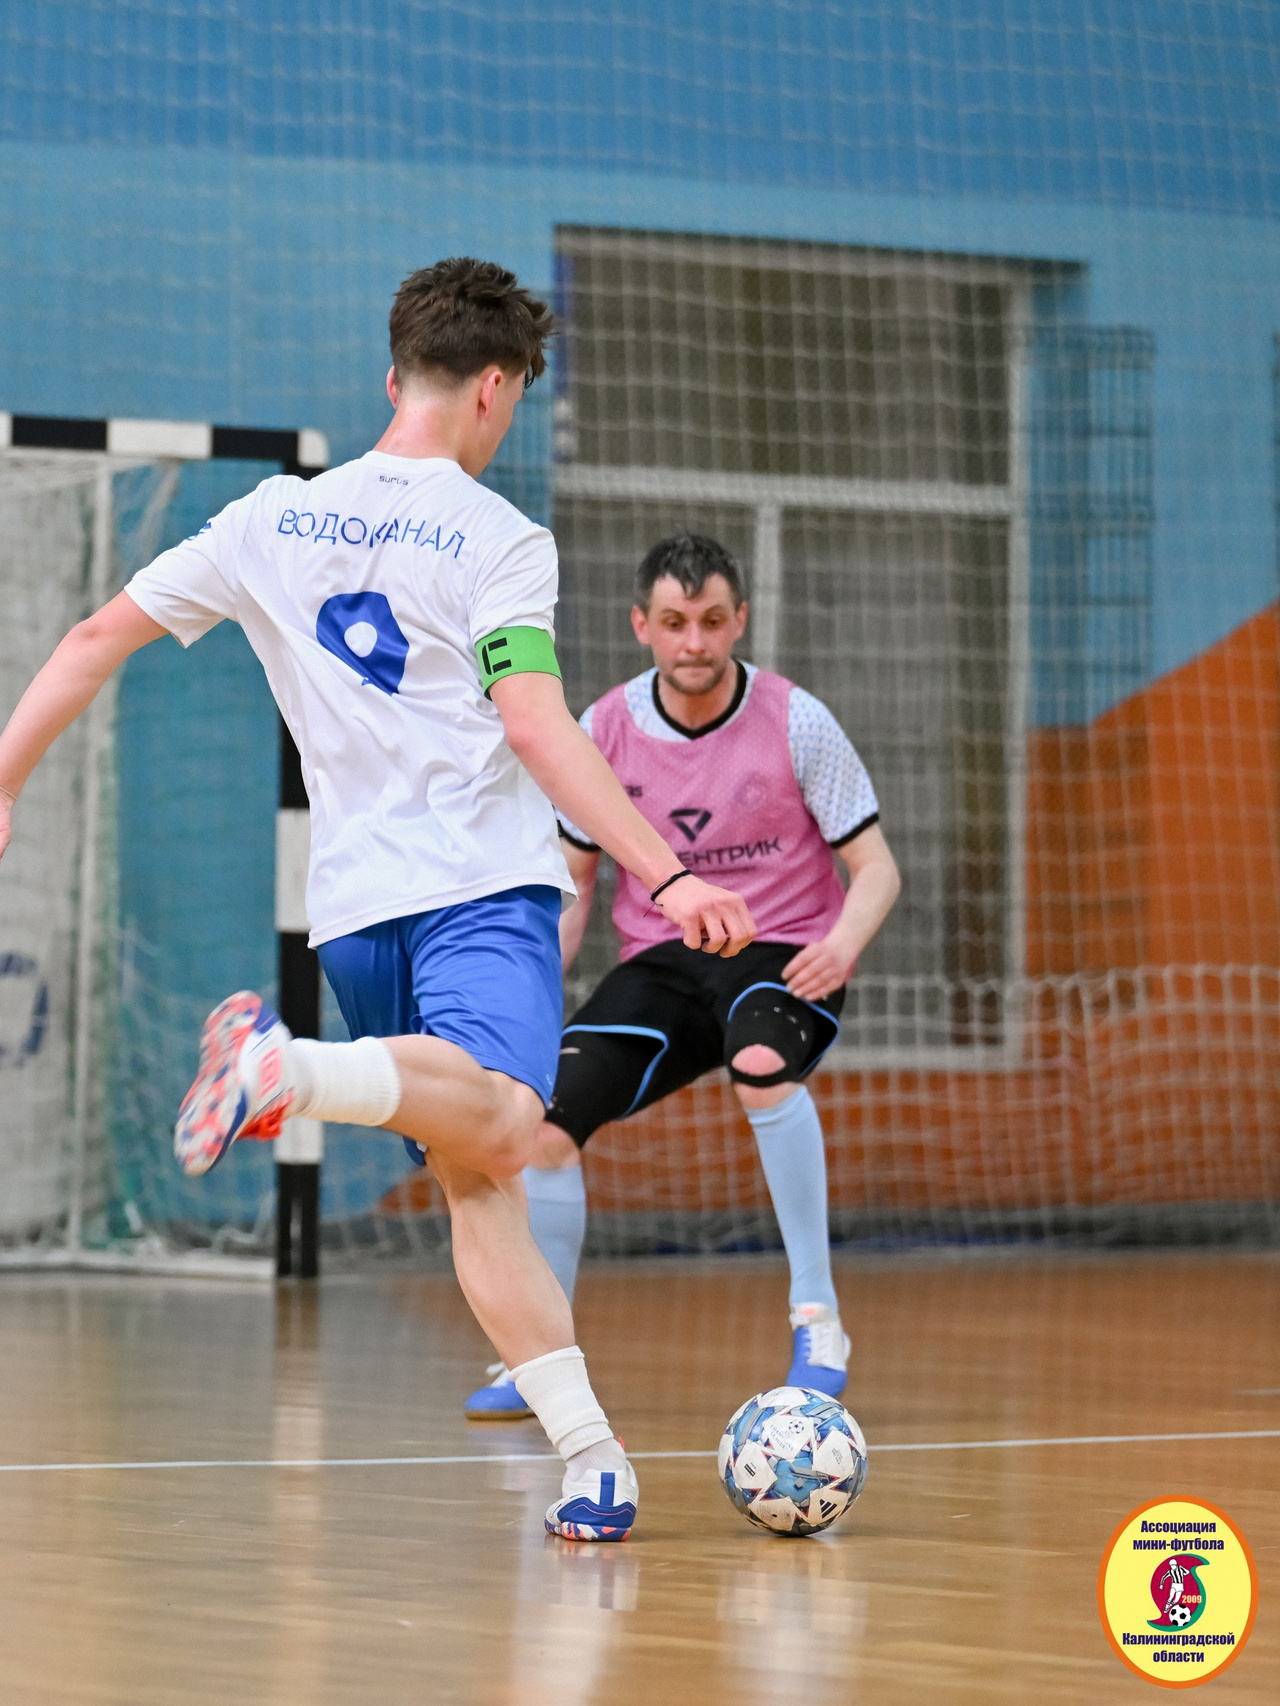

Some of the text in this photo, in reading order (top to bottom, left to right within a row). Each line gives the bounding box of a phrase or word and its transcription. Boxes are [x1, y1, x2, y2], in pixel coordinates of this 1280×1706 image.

[379, 475, 409, 486] surus
[277, 509, 466, 559] ВОДОКАНАЛ
[315, 590, 410, 697] 9
[676, 836, 783, 867] ЕНТРИК
